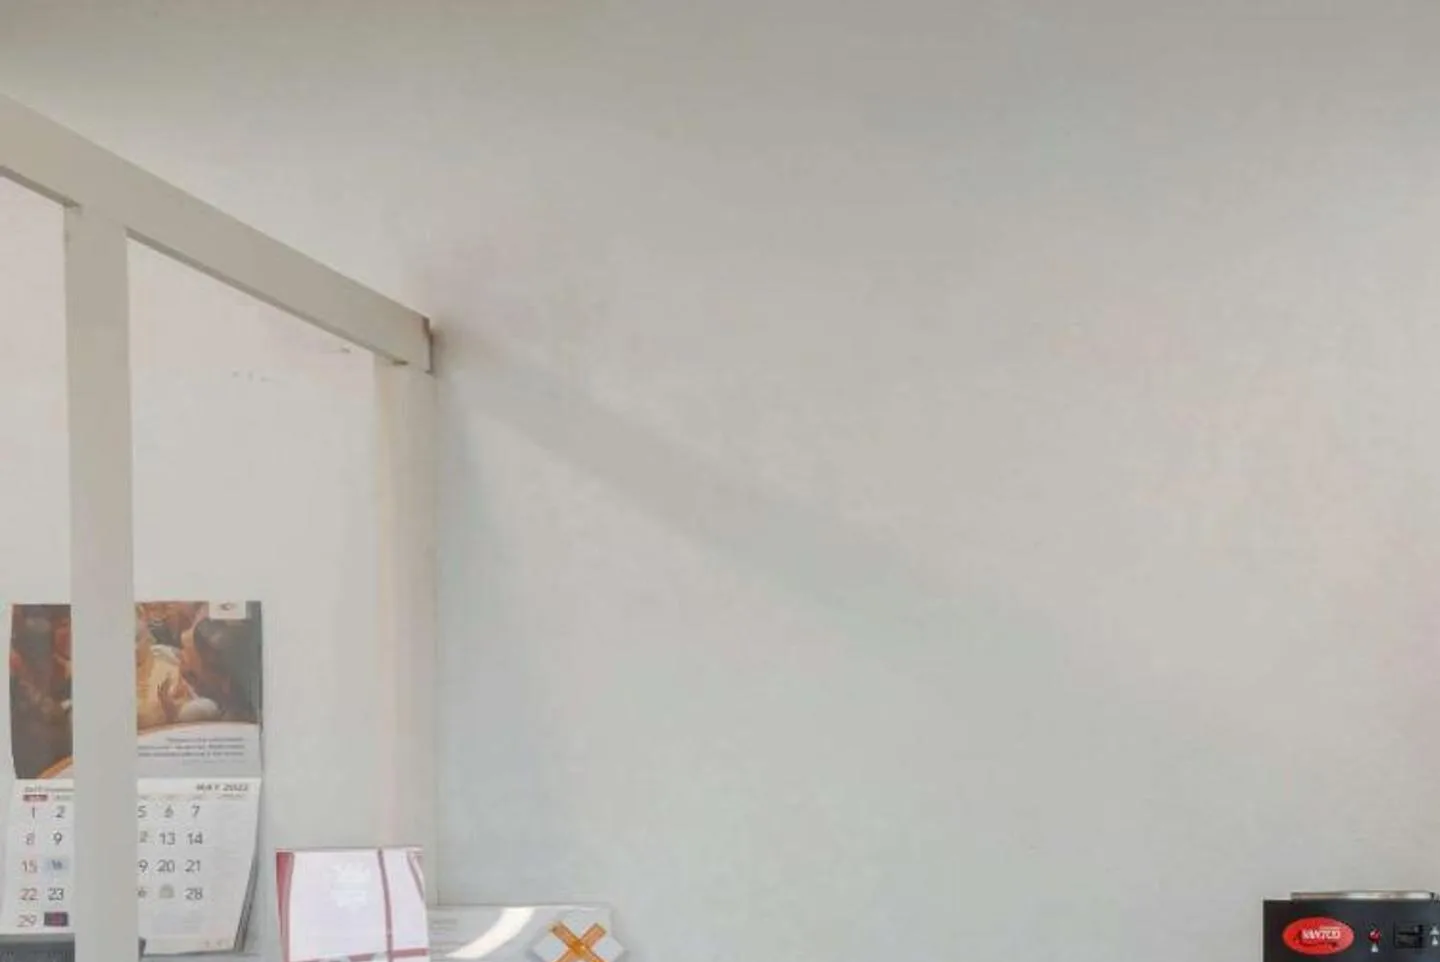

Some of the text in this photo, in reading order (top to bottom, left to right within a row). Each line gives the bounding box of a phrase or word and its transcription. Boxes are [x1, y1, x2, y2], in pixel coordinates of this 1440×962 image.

[191, 805, 200, 818] 7
[53, 832, 63, 846] 9
[159, 832, 176, 845] 13
[187, 832, 203, 845] 14
[157, 859, 175, 873] 20
[185, 859, 201, 873] 21
[20, 887, 65, 901] 22 23
[185, 887, 203, 901] 28
